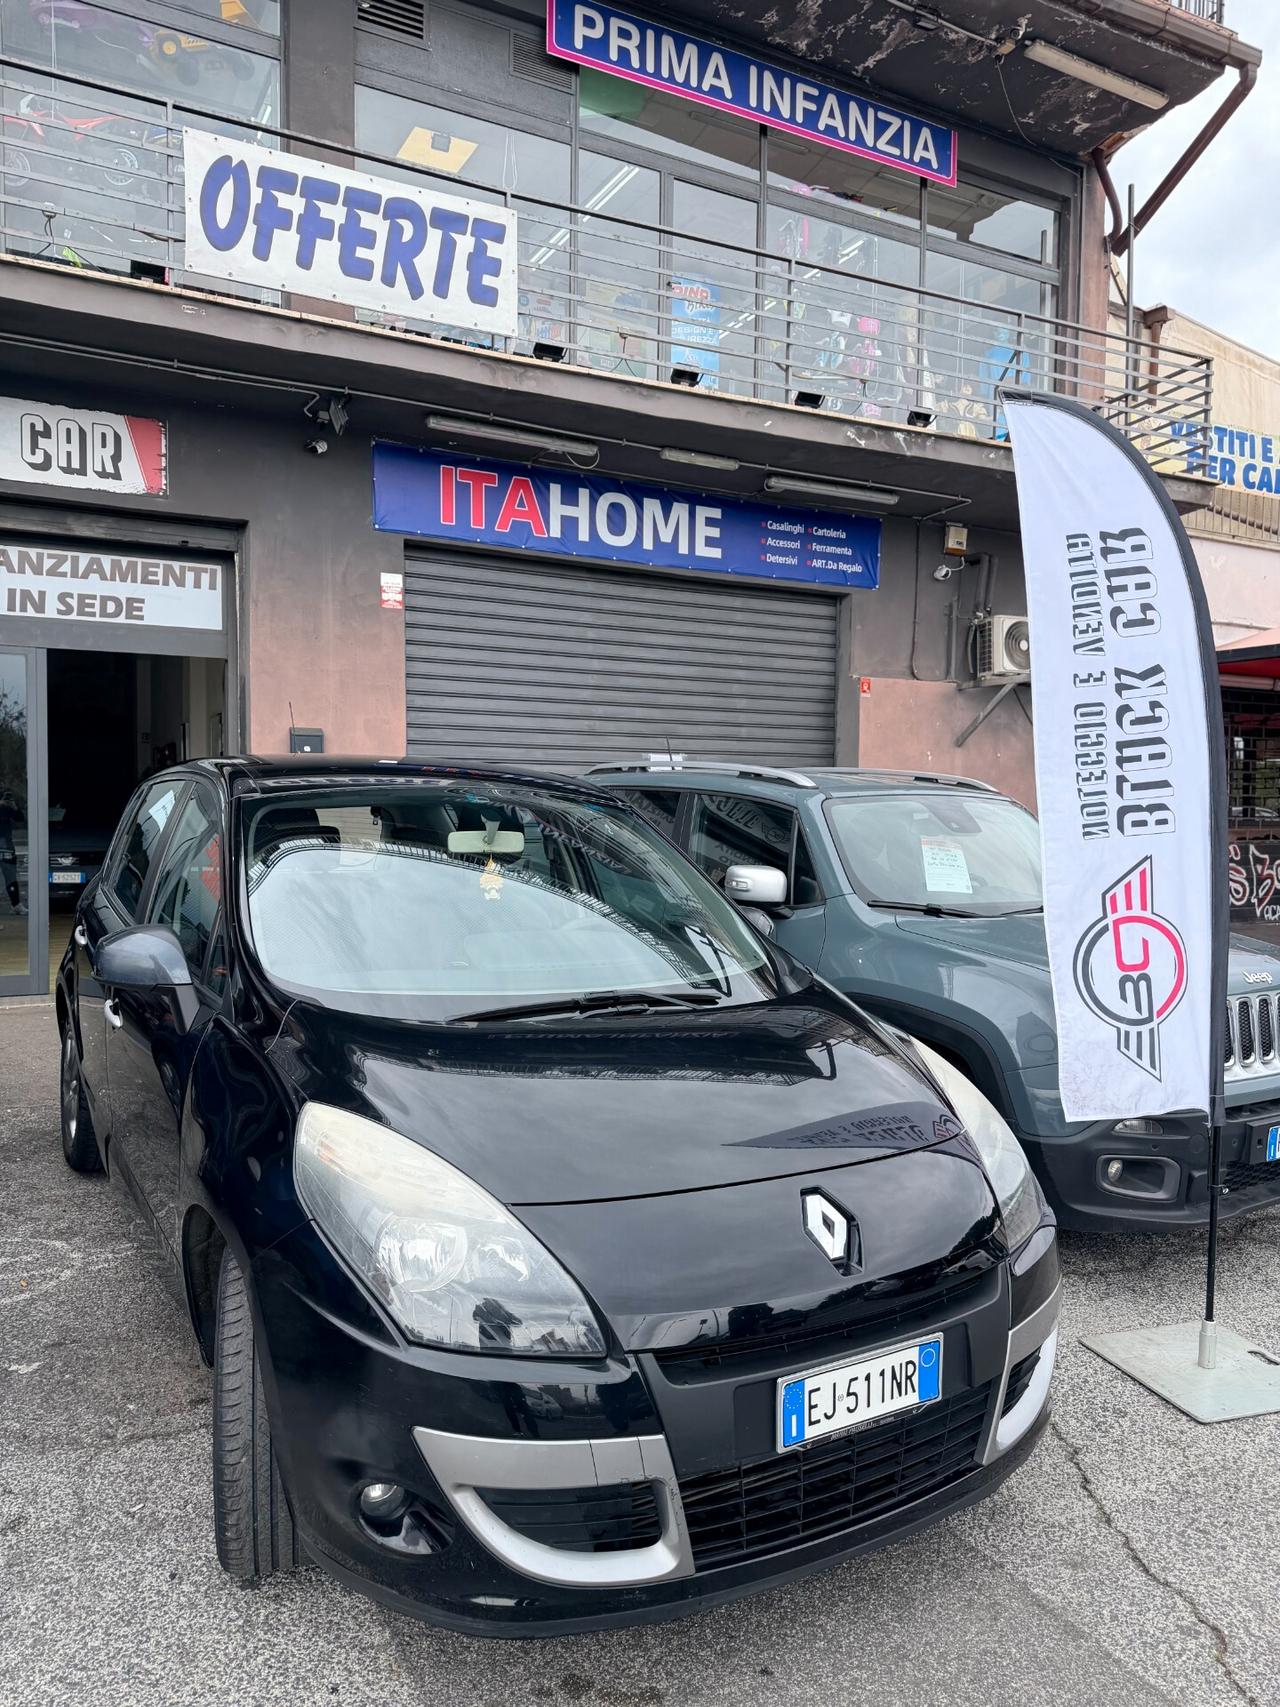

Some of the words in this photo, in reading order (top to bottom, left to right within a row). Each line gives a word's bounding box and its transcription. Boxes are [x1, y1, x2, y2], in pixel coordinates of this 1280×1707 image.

[573, 4, 733, 99] PRIMA
[748, 65, 939, 170] INFANZIA
[199, 154, 507, 308] OFFERTE
[20, 413, 122, 481] CAR
[767, 520, 805, 534] Casalinghi
[812, 526, 847, 539] Cartoleria
[766, 537, 801, 549] Accessori
[812, 542, 852, 556] Ferramenta
[766, 553, 798, 565] Detersivi
[838, 562, 863, 573] Regalo
[6, 587, 46, 615] IN
[56, 592, 146, 621] SEDE
[1242, 970, 1273, 984] Jeep
